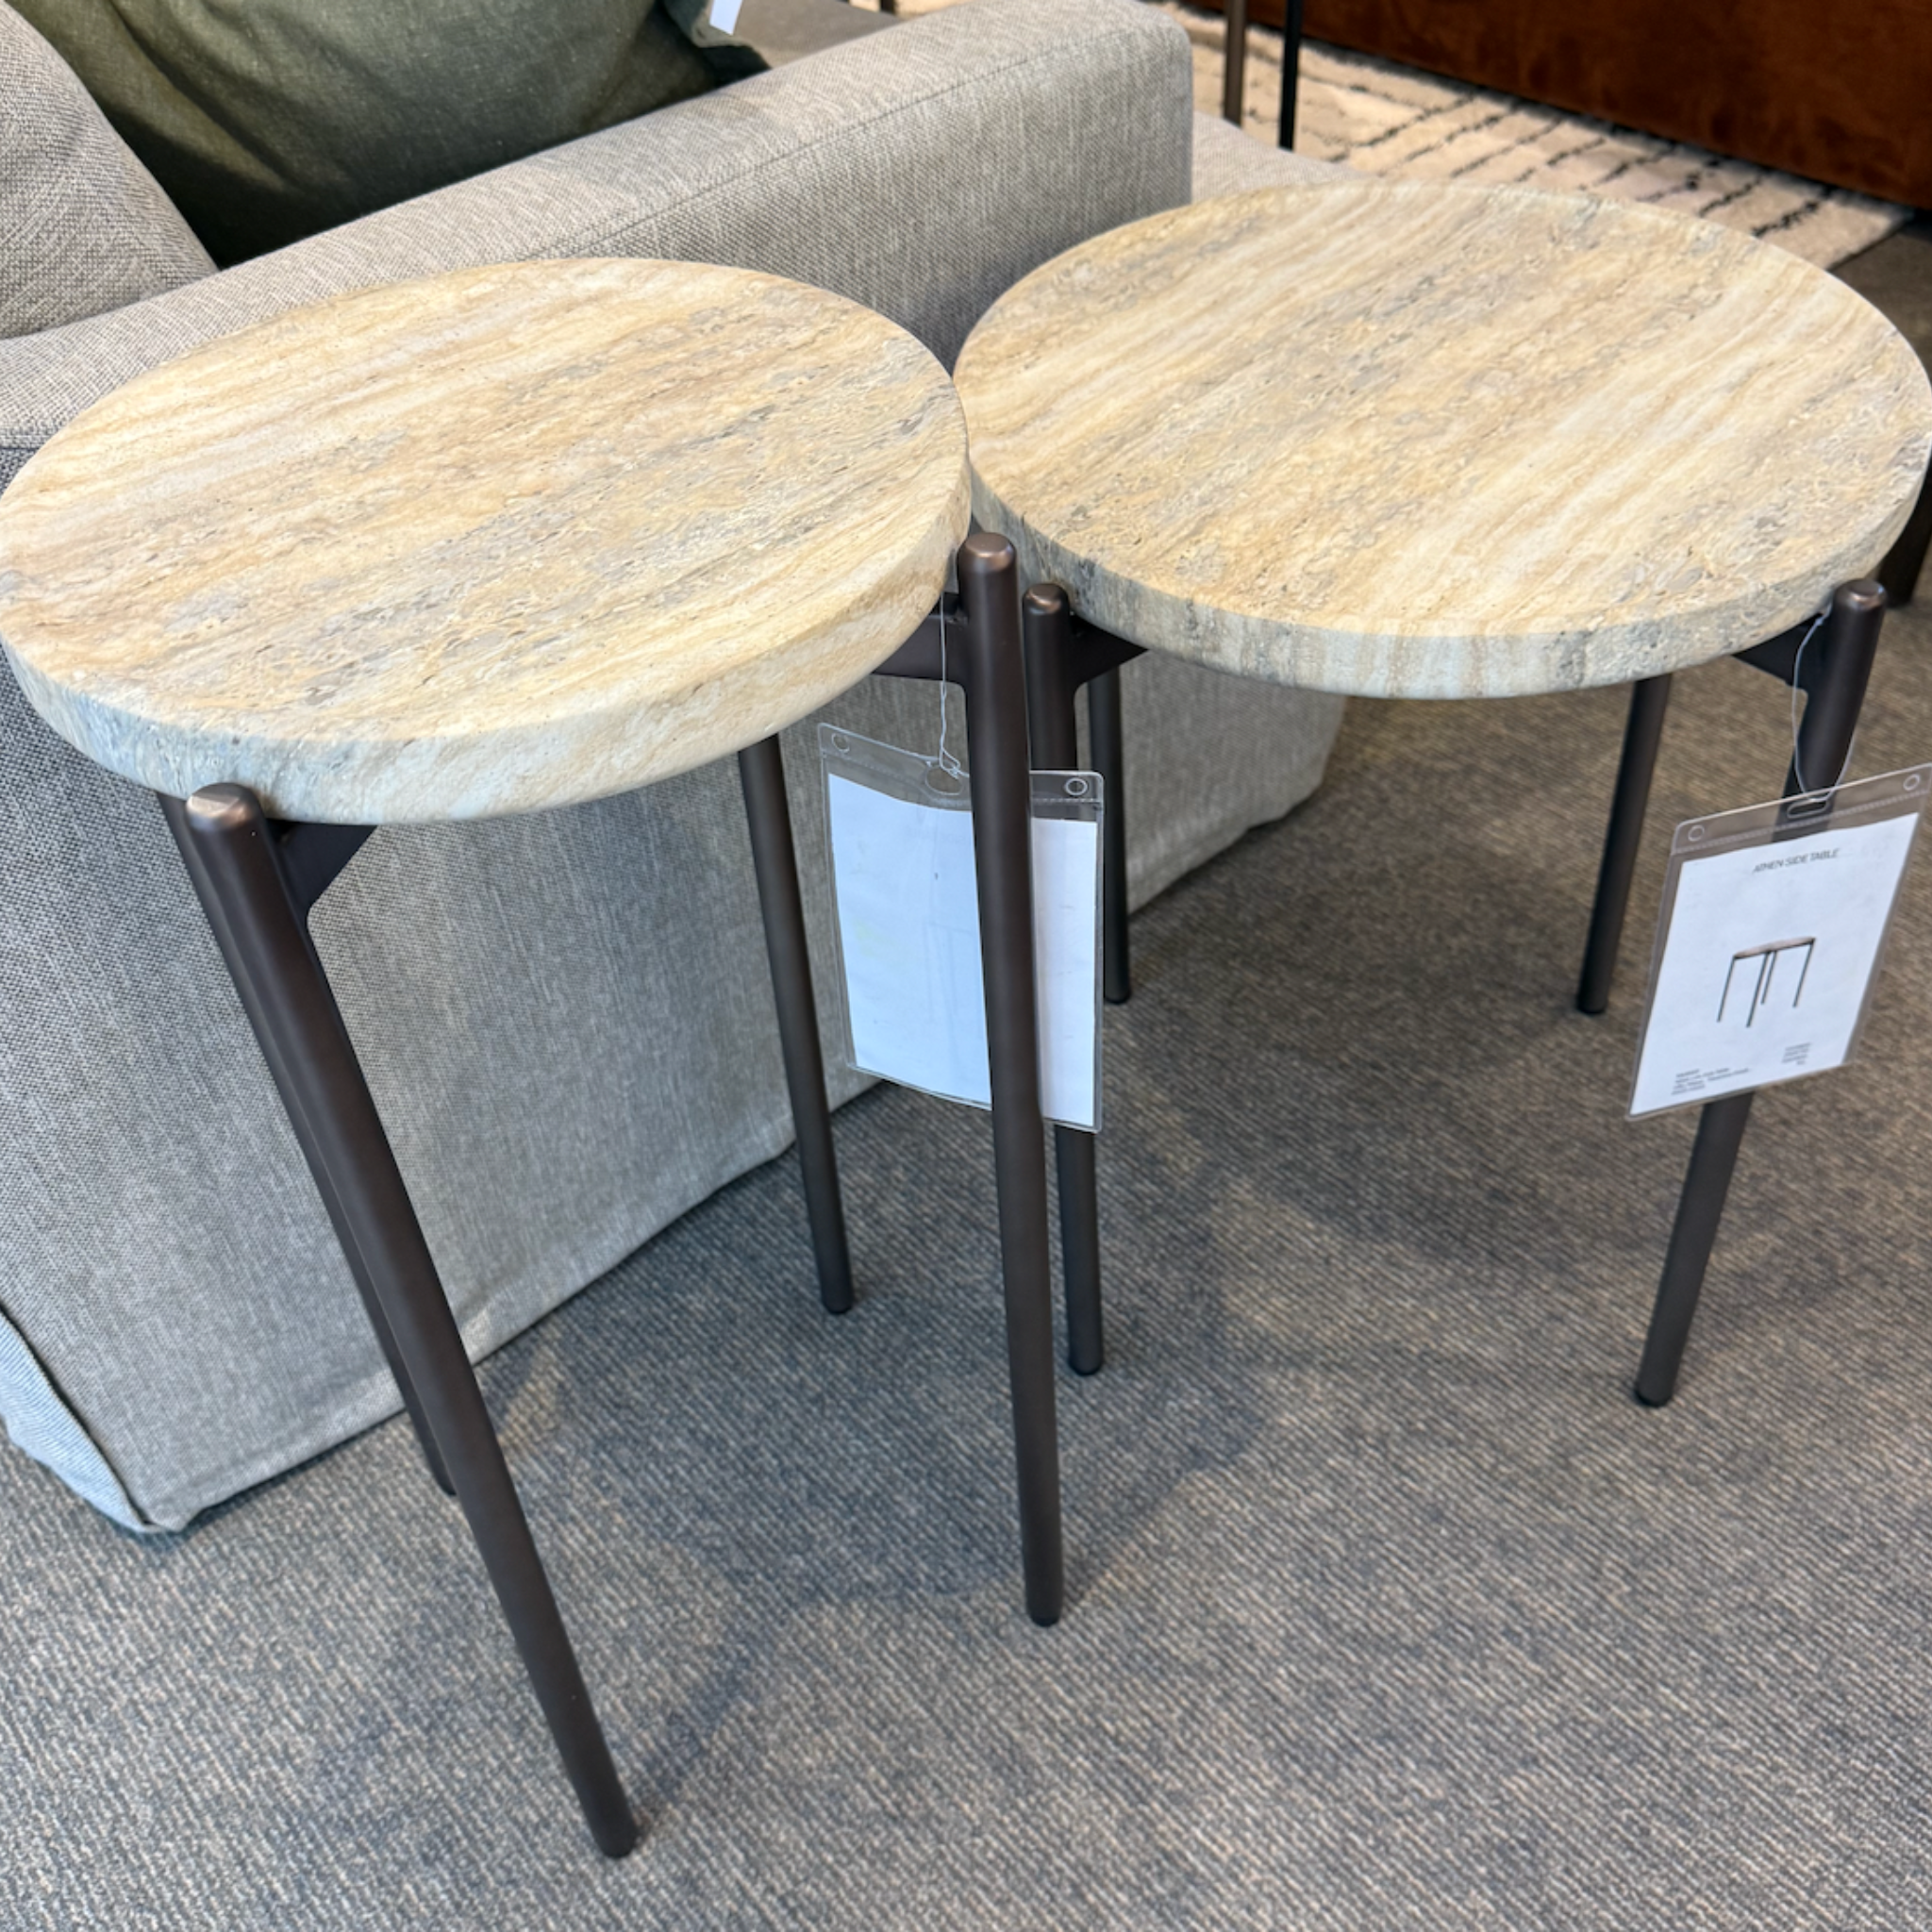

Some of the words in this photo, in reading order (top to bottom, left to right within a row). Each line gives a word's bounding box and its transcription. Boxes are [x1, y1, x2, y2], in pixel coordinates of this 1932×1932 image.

[1753, 859, 1784, 873] ATHEN
[1785, 854, 1808, 866] SIDE
[1809, 848, 1840, 861] TABLE
